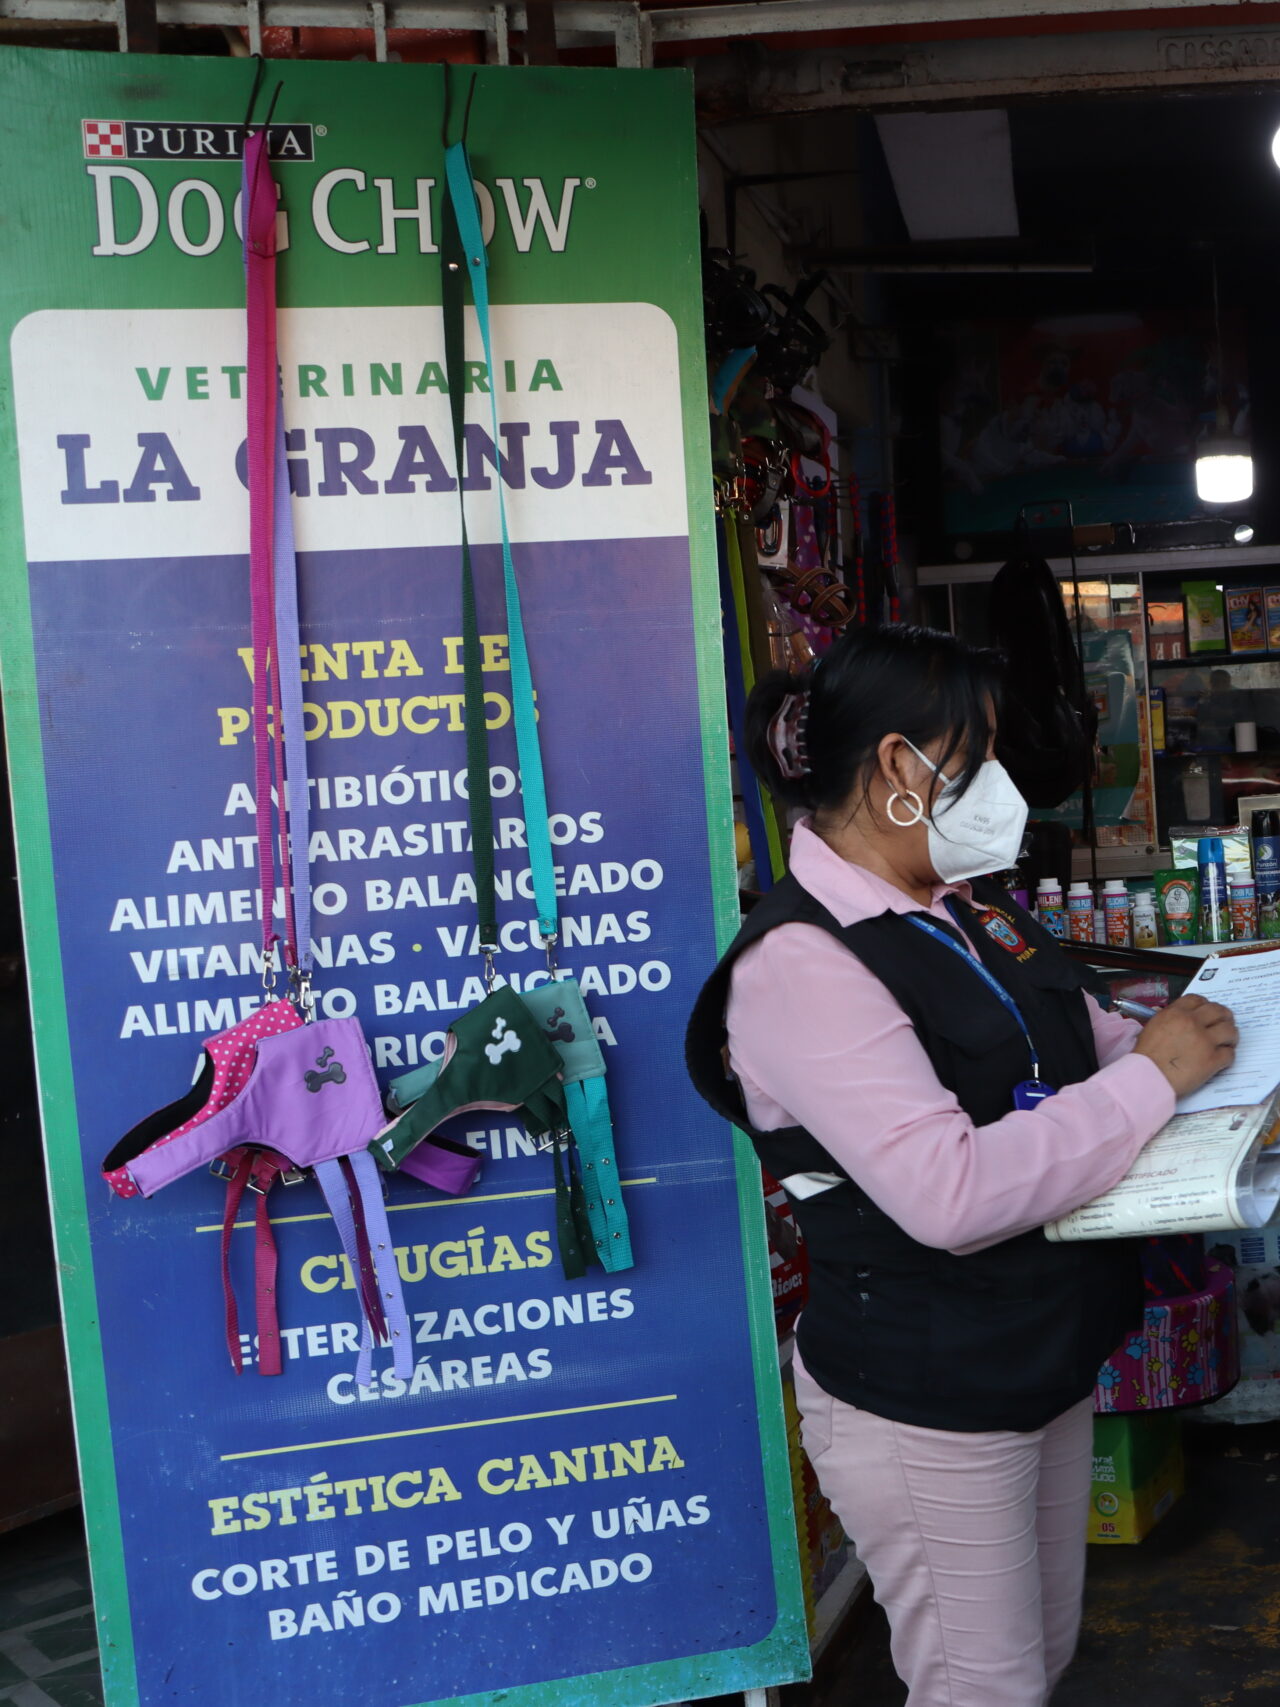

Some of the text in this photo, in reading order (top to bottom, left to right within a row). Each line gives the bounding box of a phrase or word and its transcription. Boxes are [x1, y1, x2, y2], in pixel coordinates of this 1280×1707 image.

[133, 126, 306, 156] PURIA
[136, 358, 563, 401] VETRINARIA
[56, 432, 201, 504] LA
[236, 639, 424, 684] VNTA
[217, 690, 539, 746] PODUCTO
[223, 764, 525, 816] AIBIÓTICO
[166, 811, 605, 874] ANTARASITROS
[108, 881, 344, 932] ALIMENO
[129, 931, 396, 984] VITAMNAS
[118, 987, 357, 1039] ALIMETO
[300, 1226, 554, 1294] CIUGÍAS
[231, 1288, 635, 1368] ETERZACIONES
[326, 1348, 554, 1405] CESÁREAS
[209, 1434, 686, 1537] ESTÉTICA CANINA
[191, 1494, 711, 1601] CORTE DE PELO Y UÑAS
[268, 1552, 653, 1642] BAÑO MEDICADO
